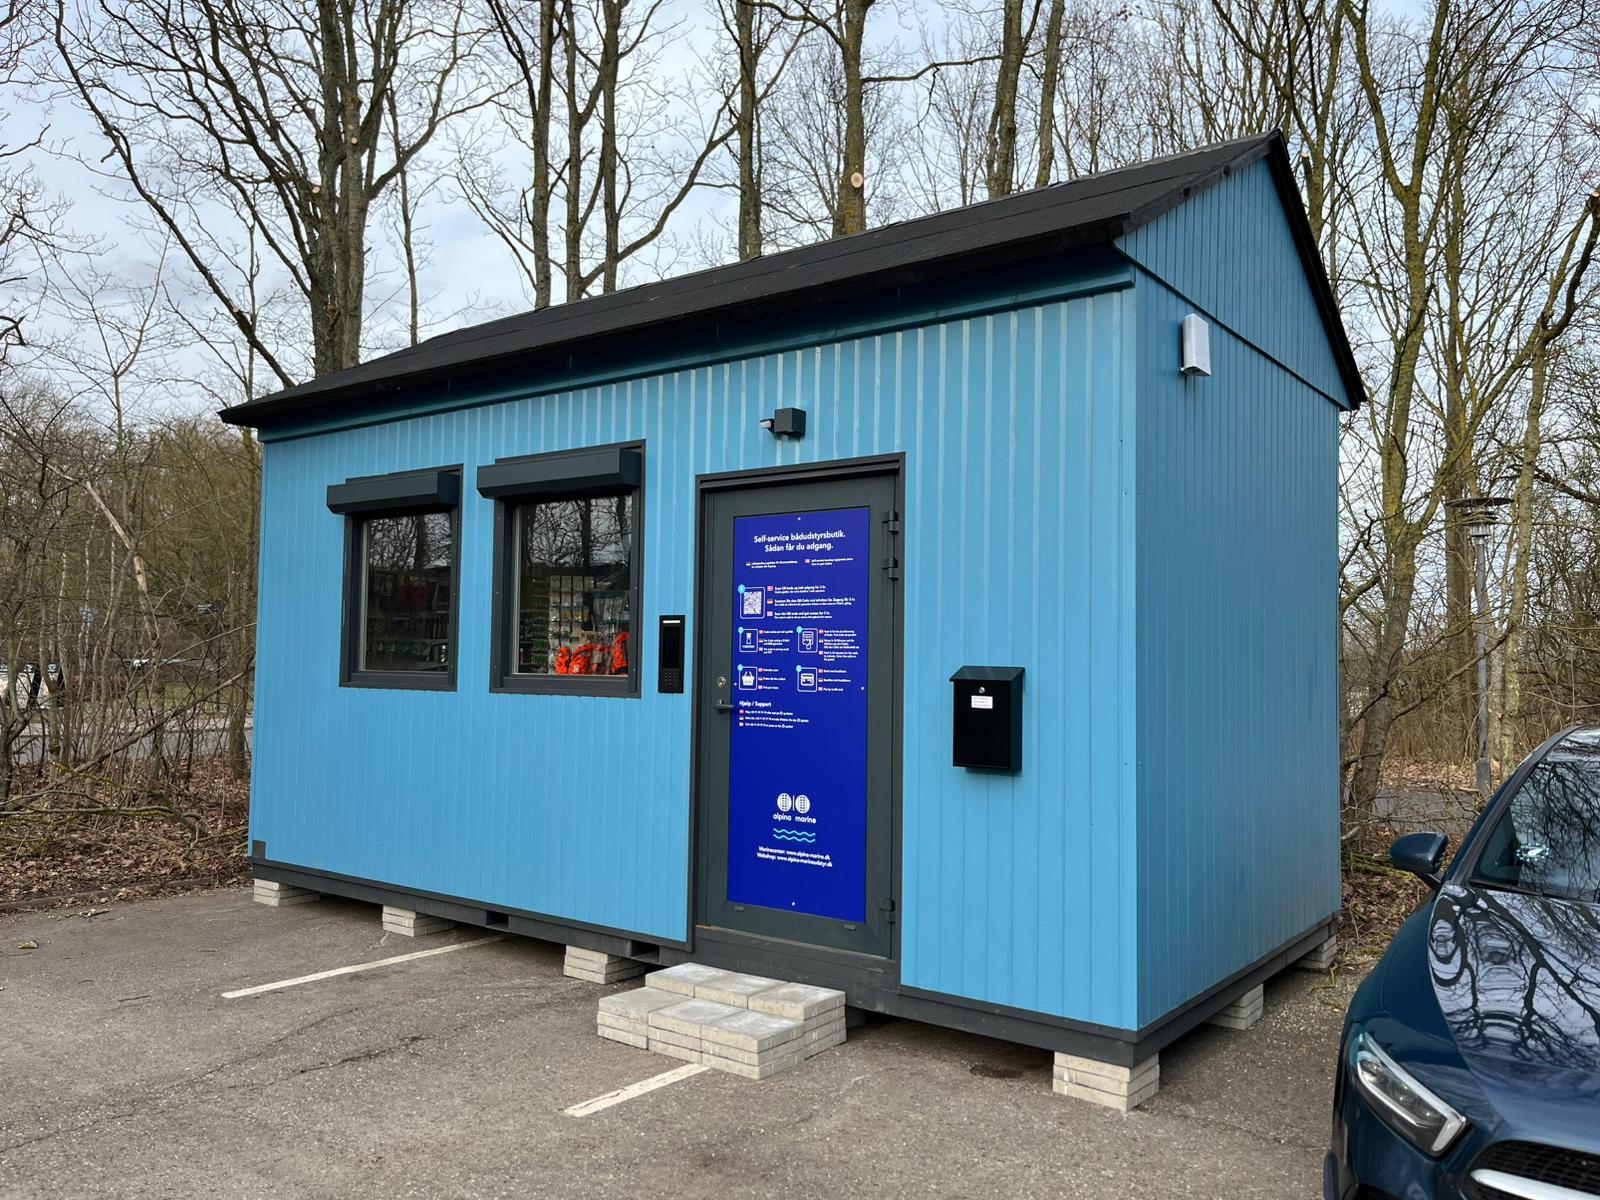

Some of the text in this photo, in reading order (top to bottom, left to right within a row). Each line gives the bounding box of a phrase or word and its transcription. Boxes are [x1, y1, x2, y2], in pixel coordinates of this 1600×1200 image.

[753, 530, 846, 543] Self-service bådudstyrsbutik.
[764, 541, 834, 552] Sådan får du adgang.
[739, 700, 751, 708] Hjælp
[755, 700, 772, 708] Support
[772, 812, 817, 824] alpina marine
[756, 852, 776, 861] Webshop:
[758, 845, 831, 860] Marinecenter: www.alpina-marine.dk
